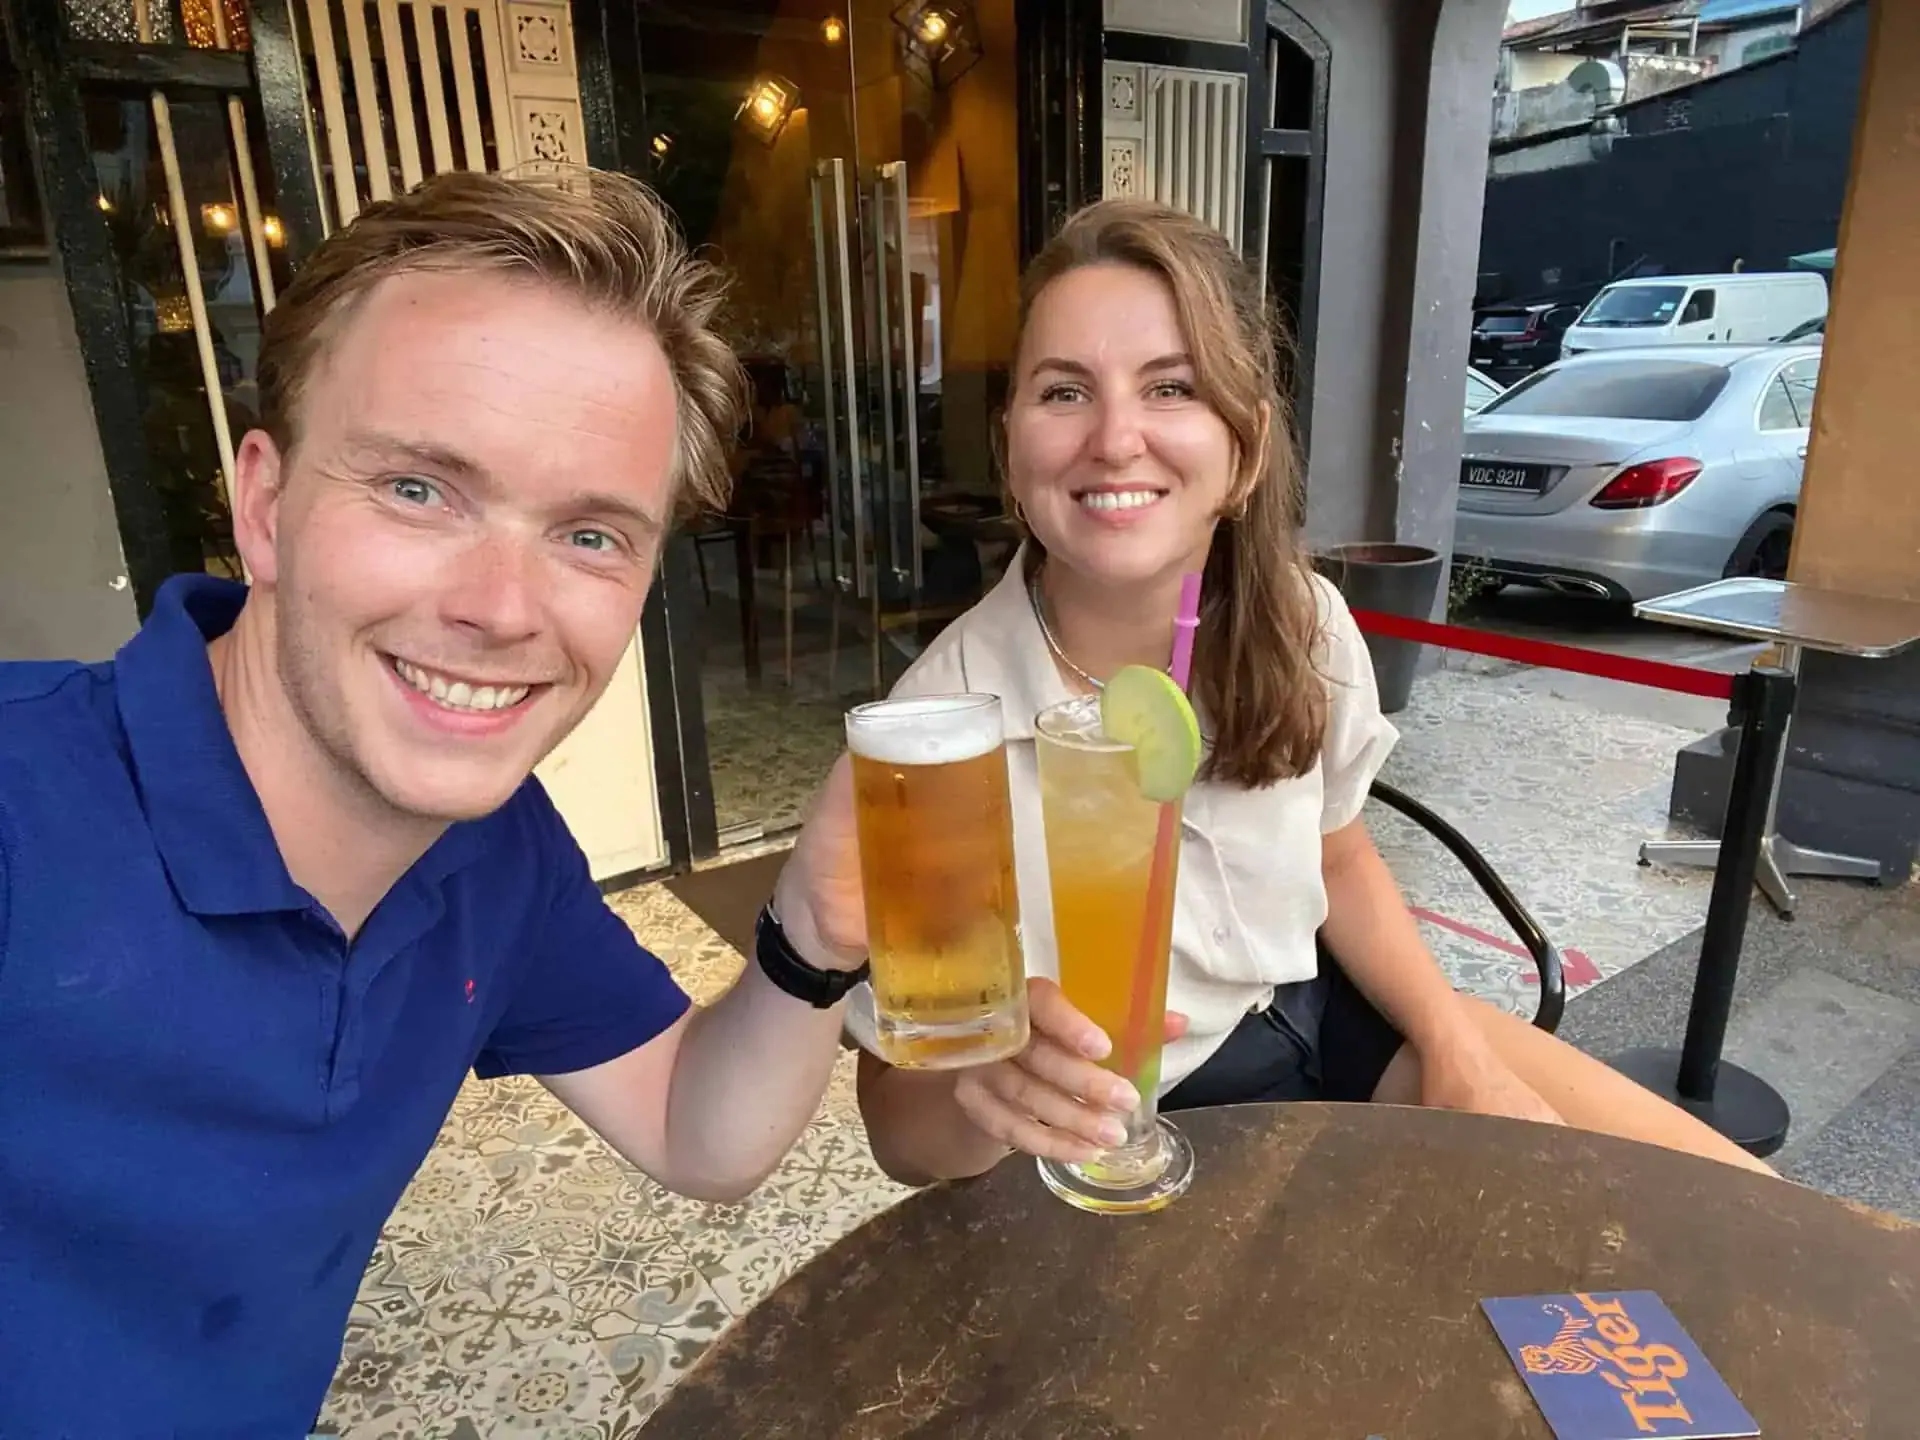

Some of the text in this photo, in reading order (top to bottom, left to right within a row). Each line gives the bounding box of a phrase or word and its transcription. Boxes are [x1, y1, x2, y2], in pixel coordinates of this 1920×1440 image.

[1469, 466, 1526, 487] VDC 9211
[1573, 1291, 1694, 1432] Tiger
